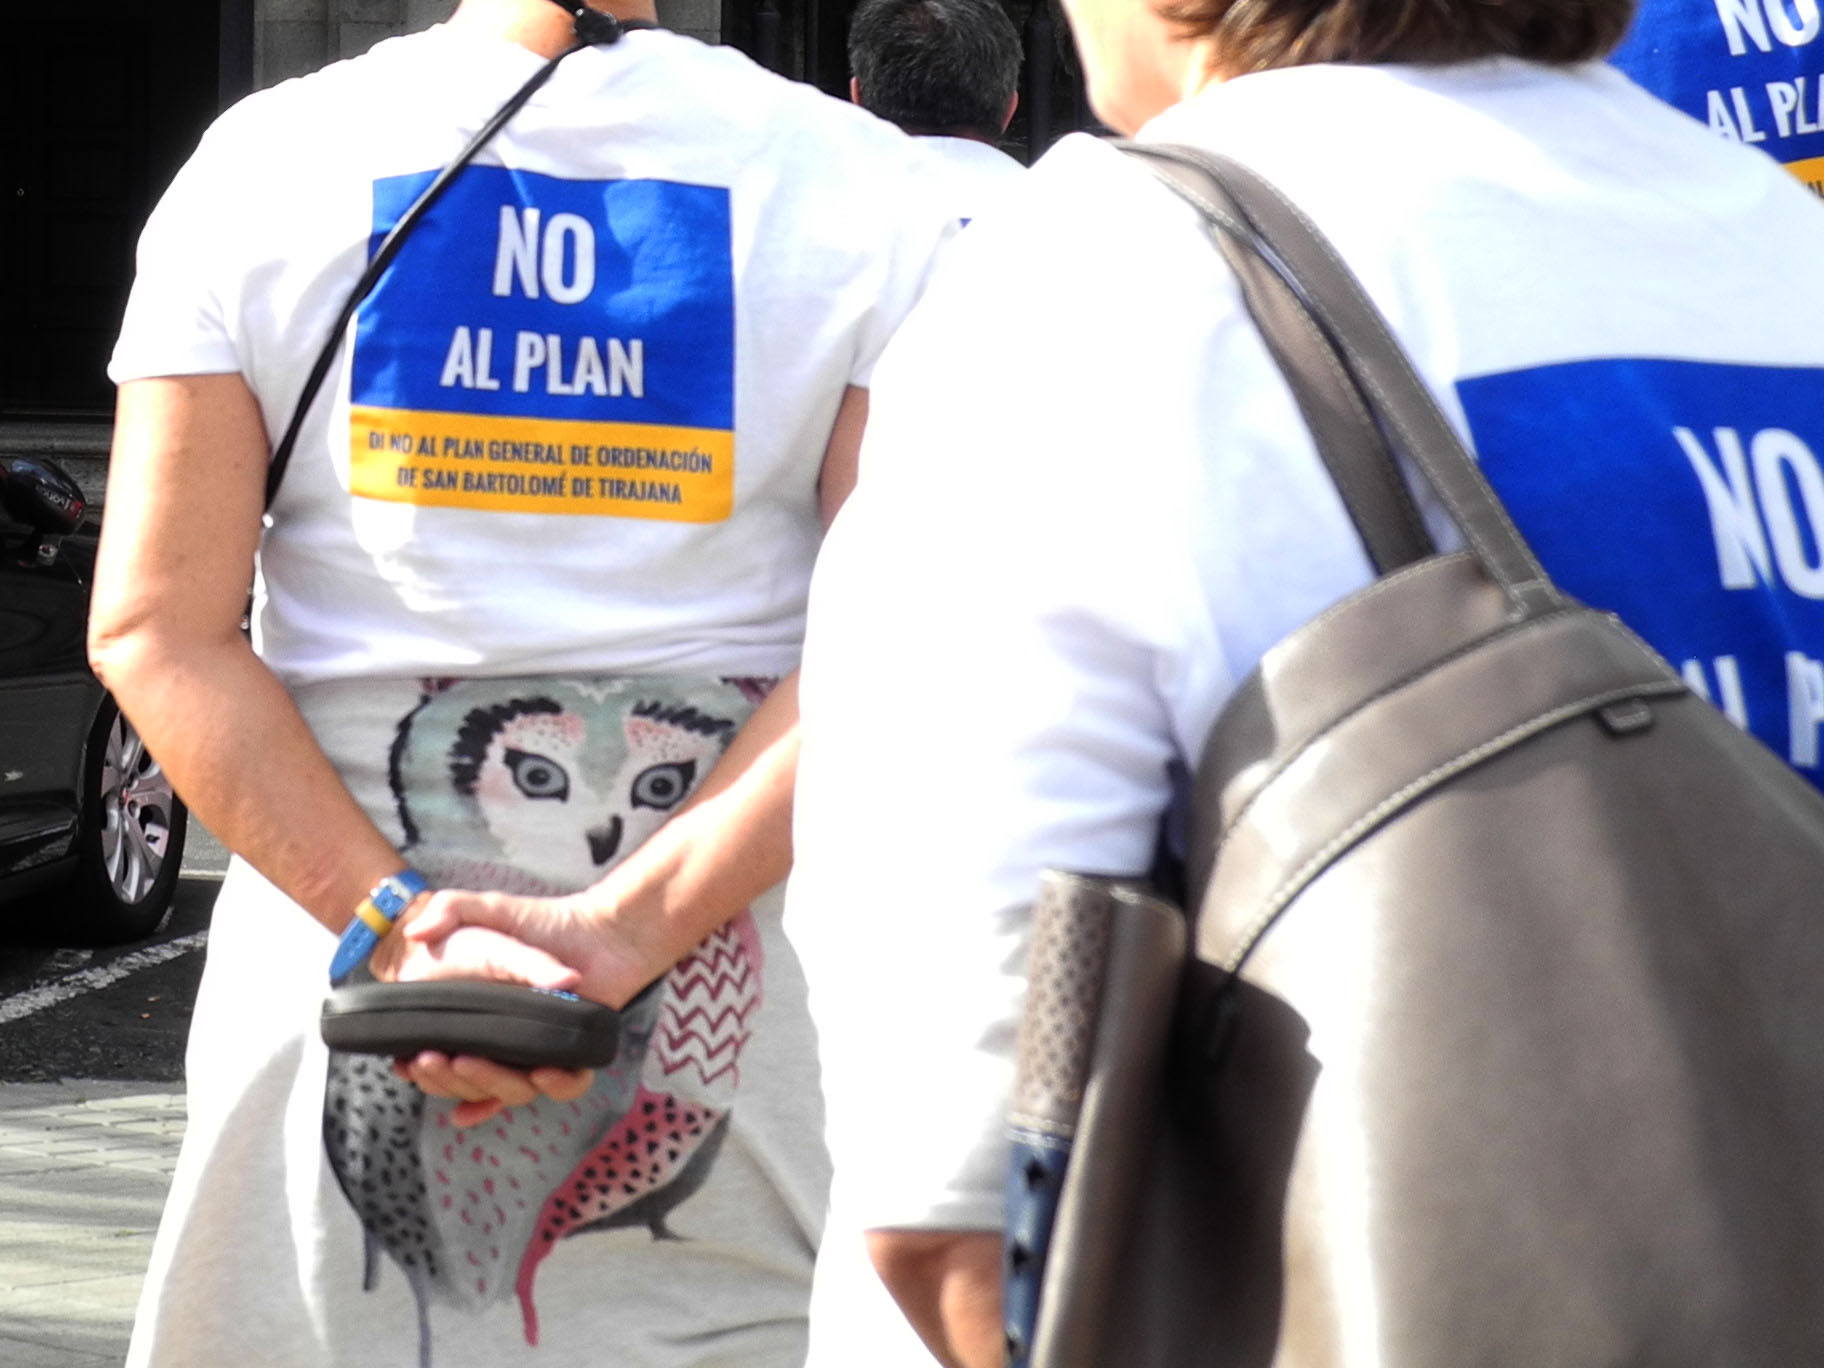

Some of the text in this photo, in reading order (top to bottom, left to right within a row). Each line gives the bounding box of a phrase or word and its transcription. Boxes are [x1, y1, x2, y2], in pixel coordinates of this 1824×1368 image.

[1706, 73, 1824, 143] AL PL
[492, 204, 596, 305] NO
[439, 325, 644, 399] AL PLAN
[368, 431, 713, 474] DI NO AL PLAN GENERAL DE ORDENACIÓN
[397, 466, 683, 505] DE SAN BARTOLOMÉ DE TIRAJANA
[1672, 425, 1824, 601] NO
